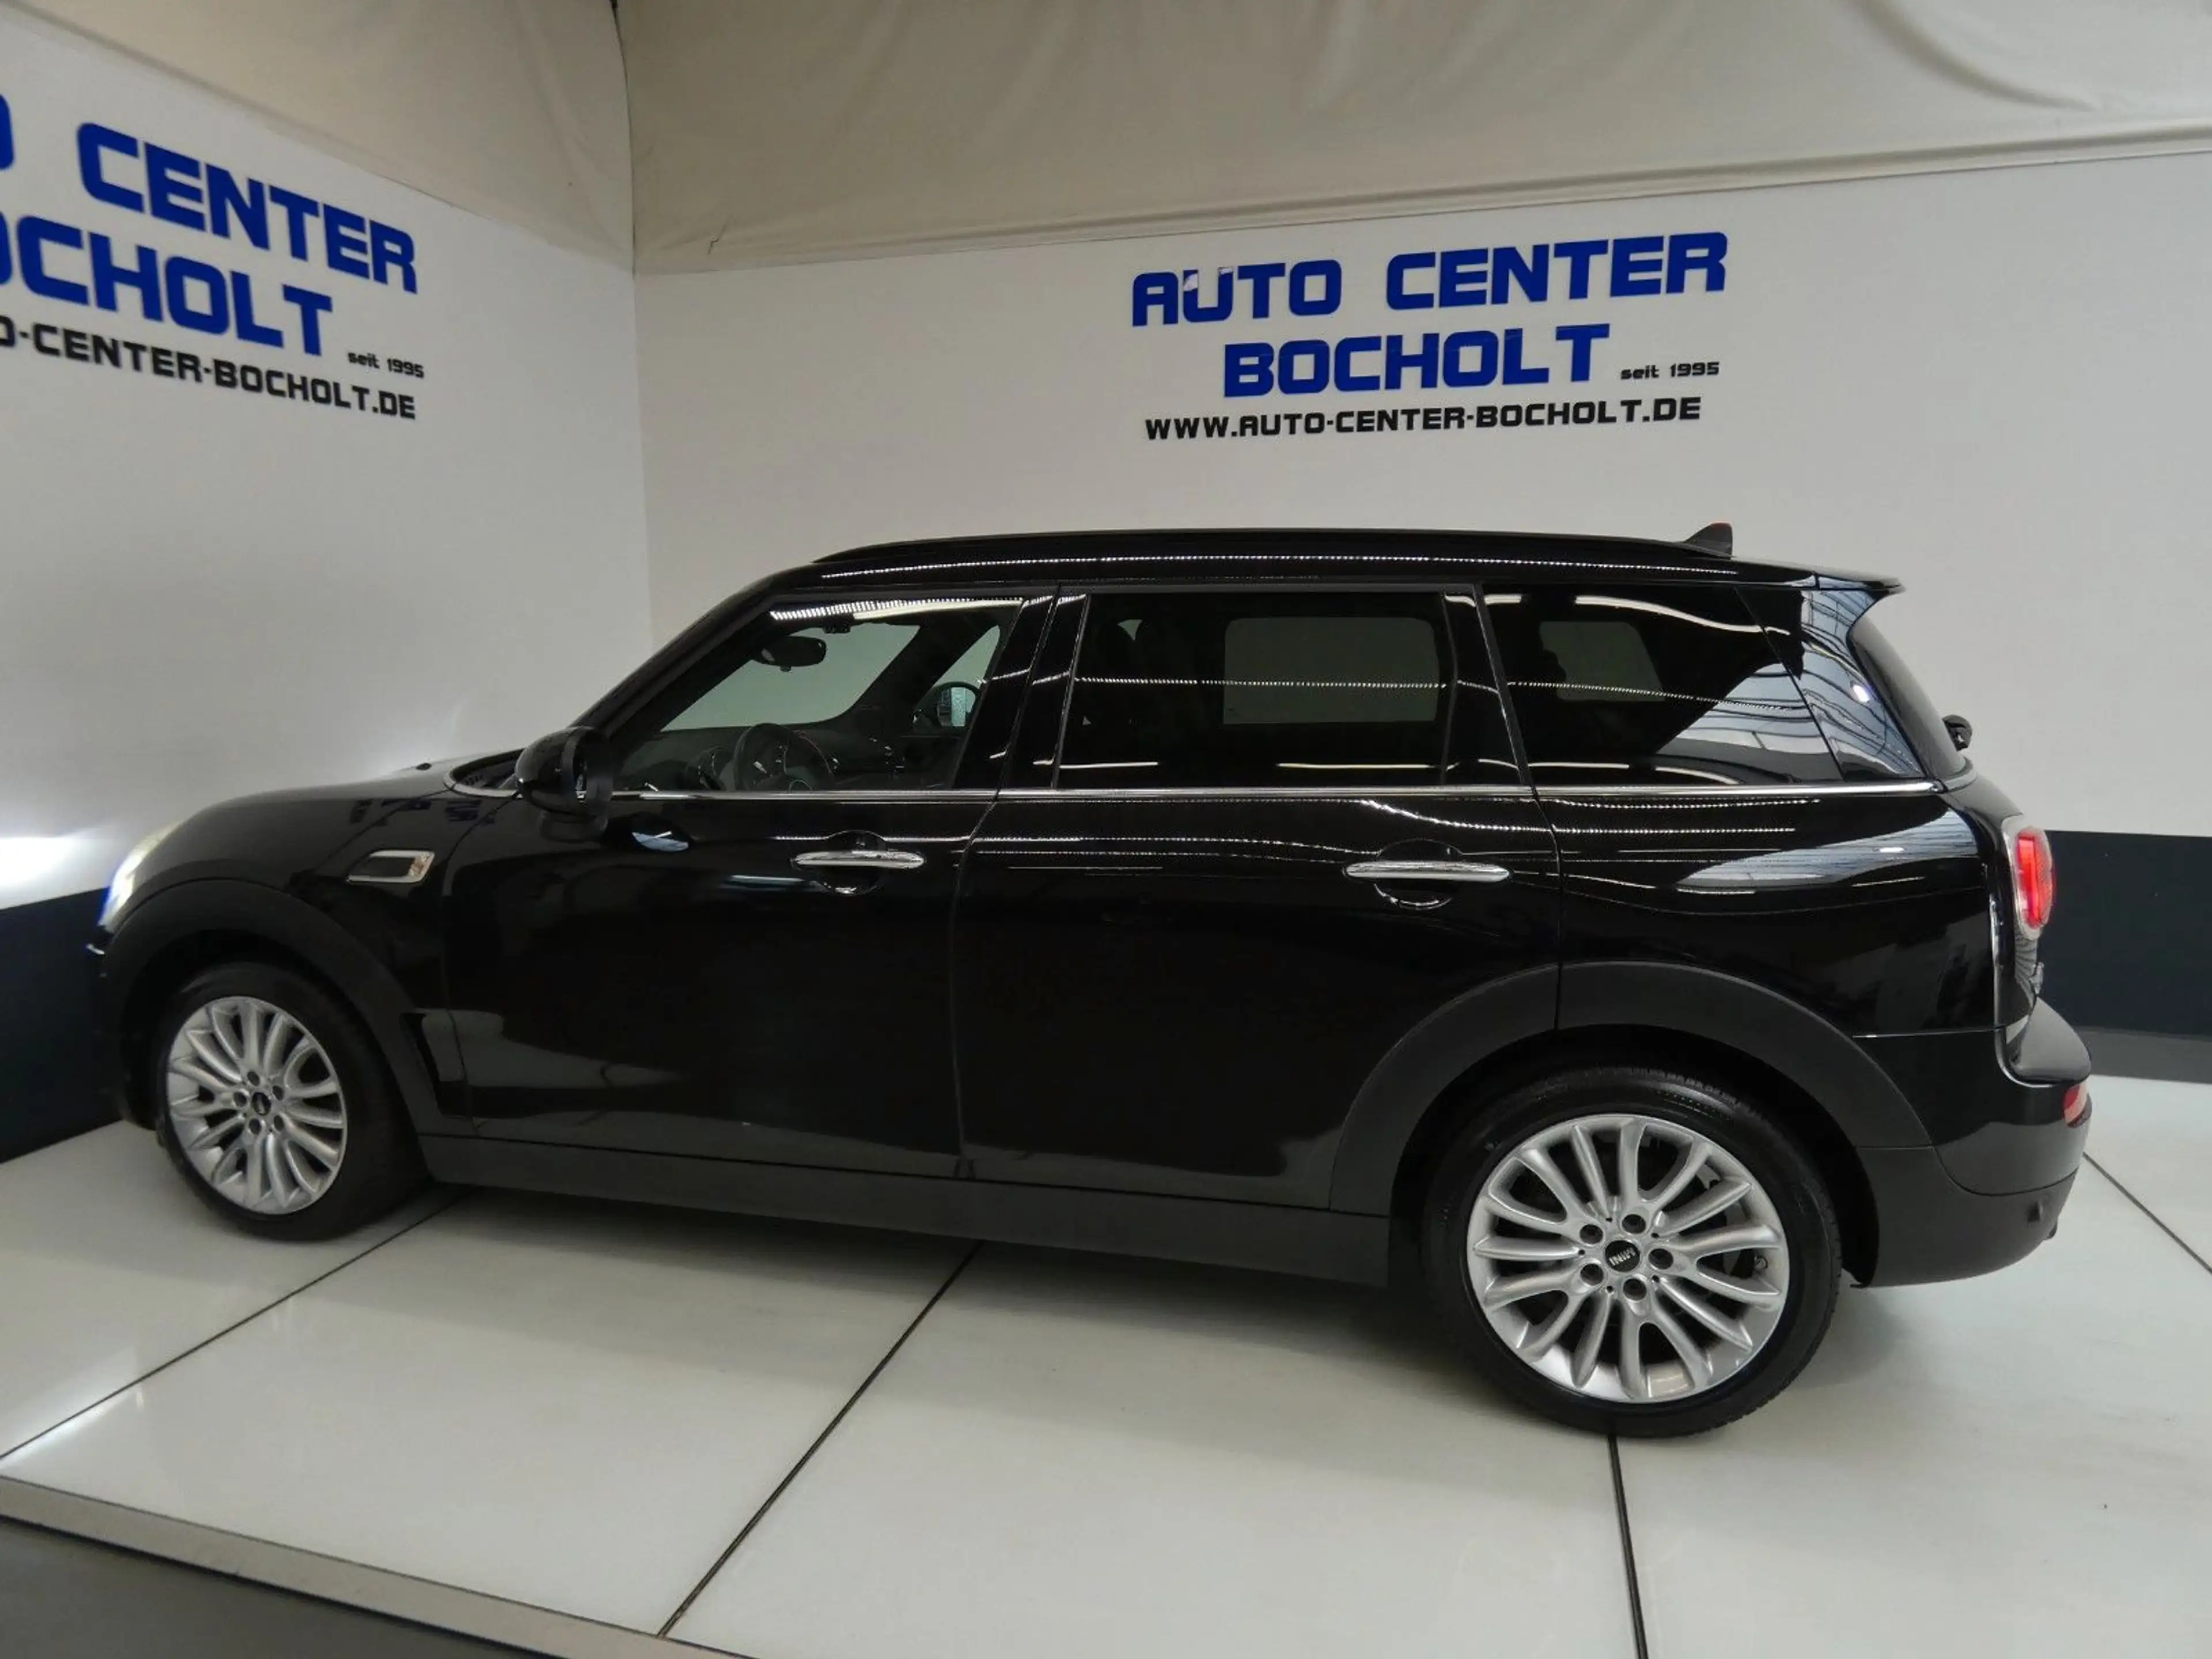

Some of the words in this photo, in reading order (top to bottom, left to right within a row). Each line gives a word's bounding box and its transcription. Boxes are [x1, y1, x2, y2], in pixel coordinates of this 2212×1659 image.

[77, 122, 418, 294] CENTER
[0, 214, 334, 357] CHOLT
[1131, 259, 1342, 328] AUTO
[1386, 231, 1729, 312] CENTER
[347, 351, 381, 370] seit
[386, 357, 425, 380] 1995
[1223, 323, 1611, 399] BOCHOLT
[1620, 363, 1660, 381] seit
[1669, 361, 1720, 378] 1995
[1144, 396, 1702, 441] WWW.AUTO-CENTER-BOCHOLT.DE
[1608, 1247, 1637, 1266] MINI
